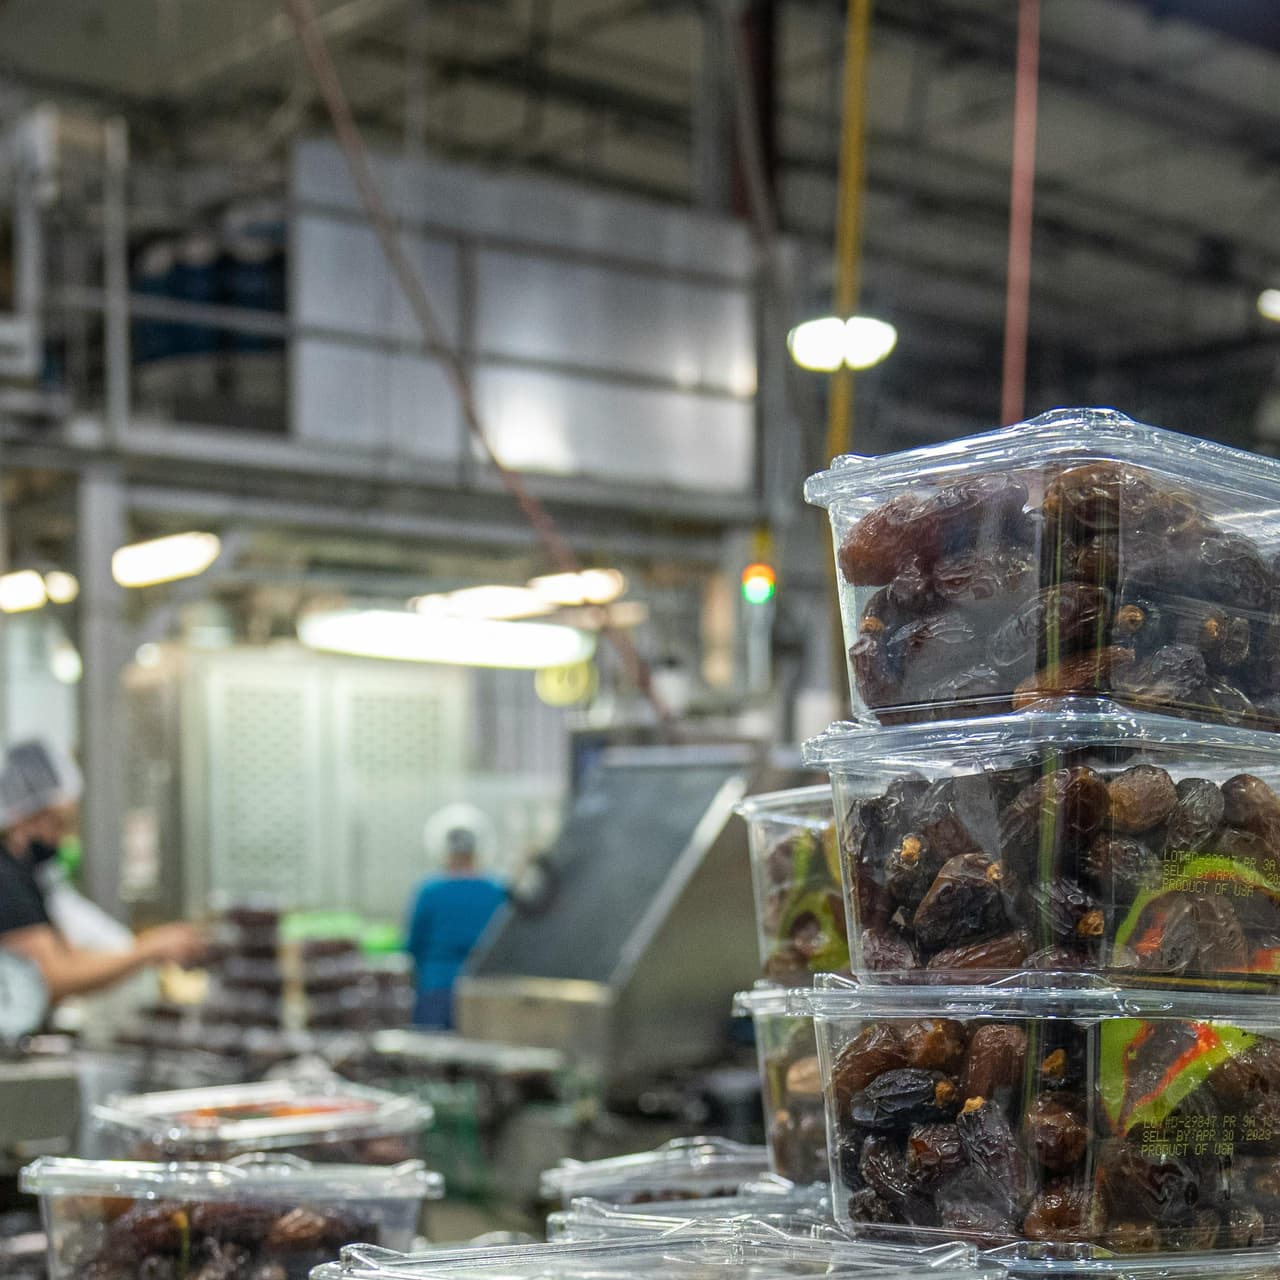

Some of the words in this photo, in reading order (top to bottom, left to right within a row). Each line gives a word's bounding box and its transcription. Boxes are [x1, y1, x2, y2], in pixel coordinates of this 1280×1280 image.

[1162, 864, 1189, 878] SELL
[1162, 877, 1209, 894] PRODUCT
[1215, 883, 1226, 895] OF
[1233, 885, 1254, 897] USA
[1223, 1116, 1236, 1127] PR
[1142, 1130, 1169, 1143] SELL
[1223, 1130, 1234, 1142] 30
[1140, 1143, 1188, 1157] PRODUCT
[1195, 1143, 1207, 1155] OF
[1214, 1144, 1234, 1157] USA
